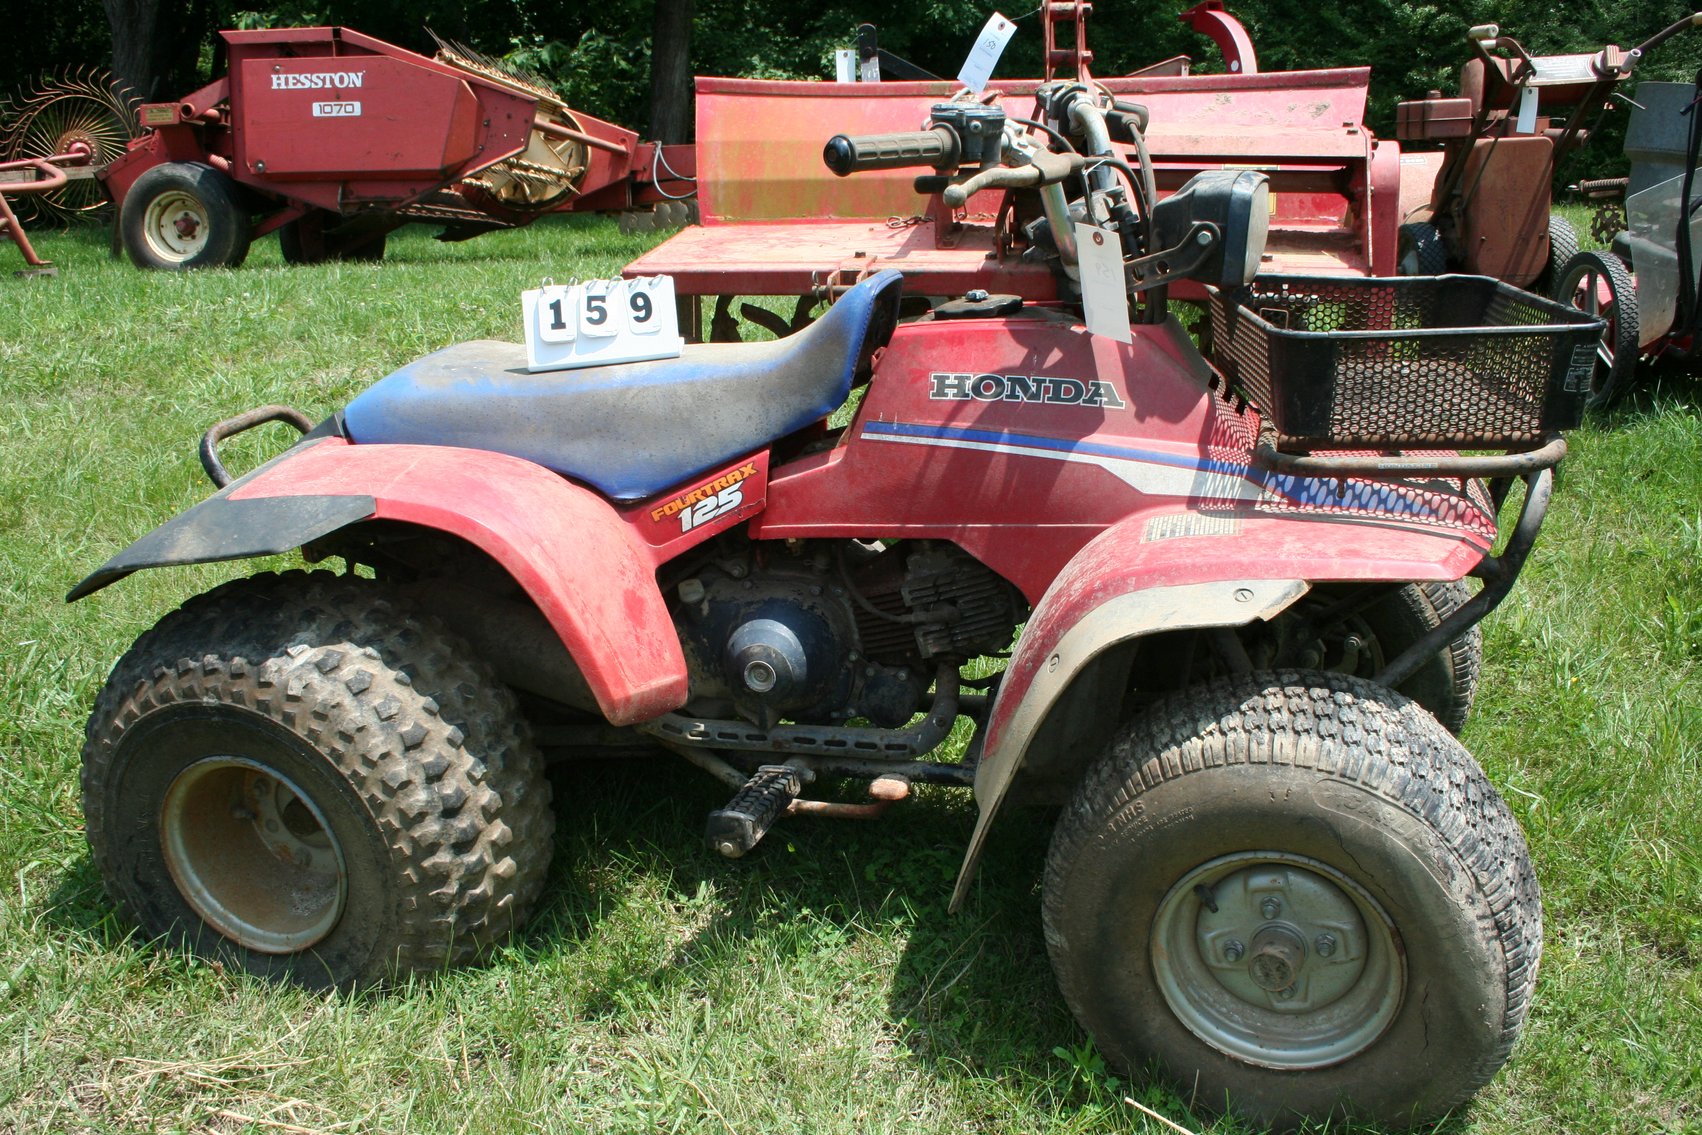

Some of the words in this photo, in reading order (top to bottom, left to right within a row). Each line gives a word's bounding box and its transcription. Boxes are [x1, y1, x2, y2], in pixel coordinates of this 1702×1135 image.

[270, 72, 363, 89] HESSTON
[319, 103, 355, 114] 1070
[929, 373, 1127, 410] HONDA
[650, 461, 758, 522] FOURTRAX
[677, 480, 744, 533] 125
